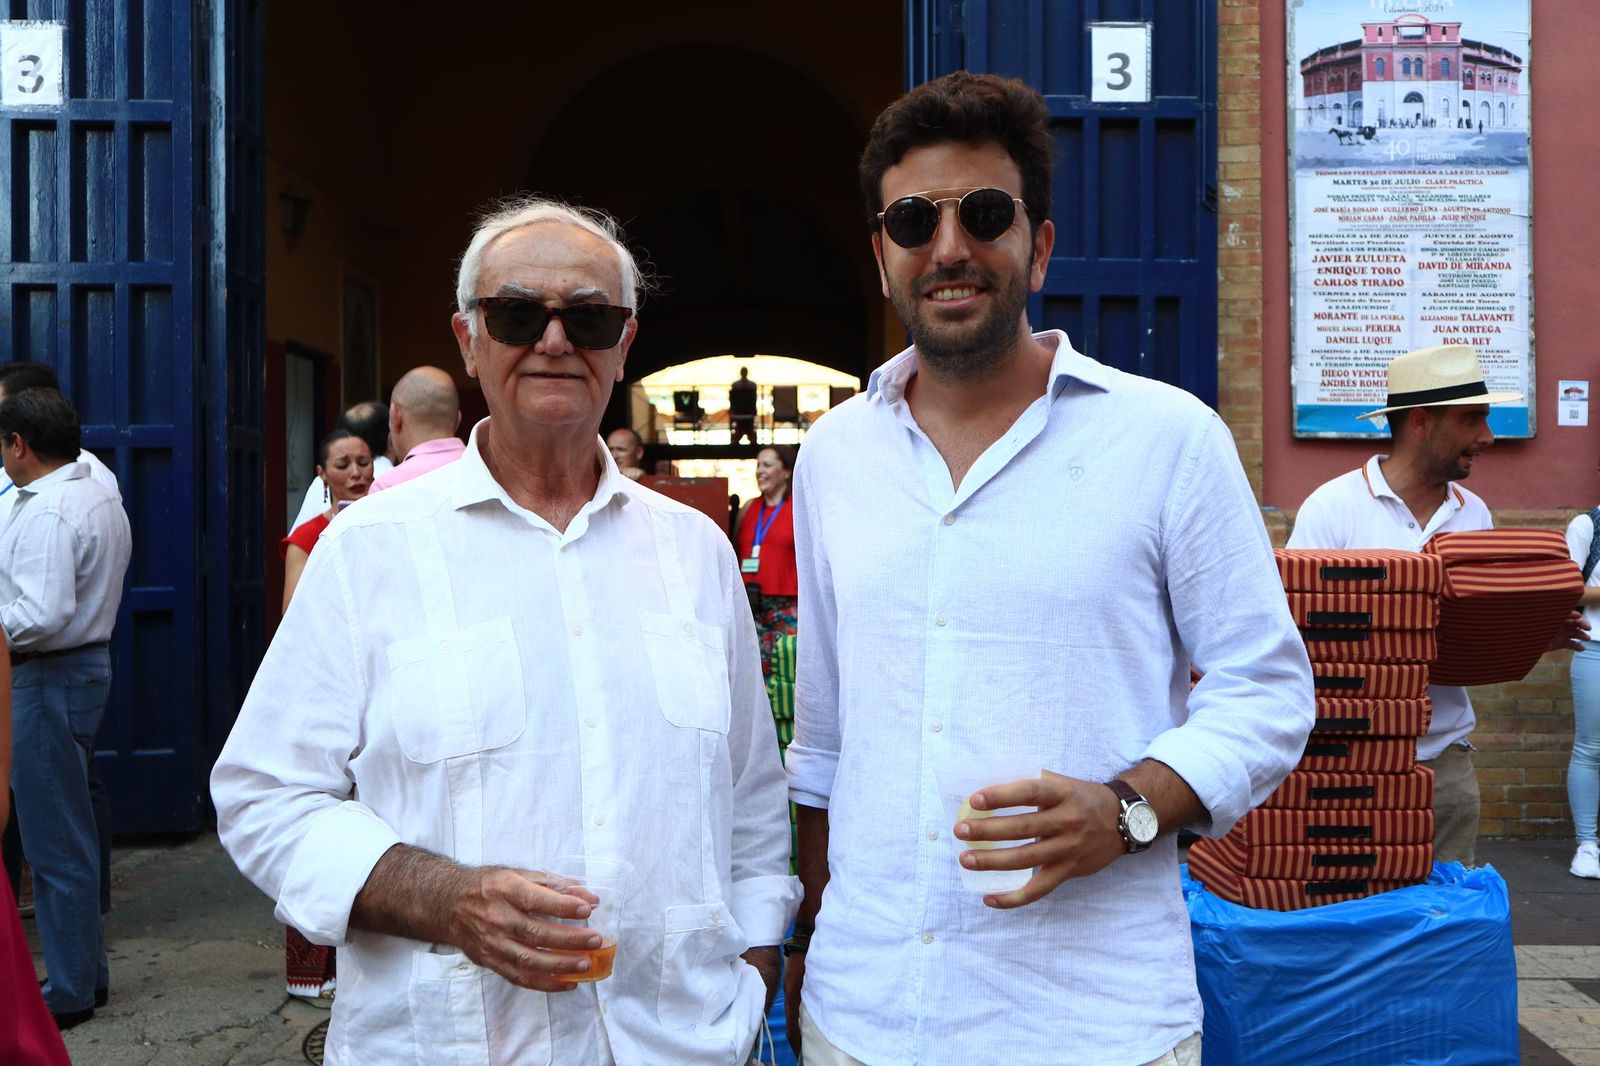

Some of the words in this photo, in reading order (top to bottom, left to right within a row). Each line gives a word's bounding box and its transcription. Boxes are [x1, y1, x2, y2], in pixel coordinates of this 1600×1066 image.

[18, 54, 44, 93] 3
[1107, 52, 1132, 90] 3
[1383, 139, 1411, 160] 40
[1312, 254, 1352, 262] JAVIER
[1356, 254, 1406, 262] ZULUETA
[1418, 262, 1448, 270] DAVID
[1451, 262, 1463, 270] DE
[1466, 262, 1512, 270] MIRANDA
[1317, 267, 1368, 276] ENRIQUE
[1314, 279, 1358, 287] CARLOS
[1361, 279, 1404, 287] TIRADO
[1314, 312, 1359, 320] MORANTE
[1460, 313, 1515, 321] TALAVANTE
[1365, 324, 1402, 333] PERERA
[1433, 325, 1460, 333] JUAN
[1462, 325, 1501, 333] ORTEGA
[1326, 336, 1360, 344] DANIEL
[1362, 336, 1393, 345] LUQUE
[1443, 337, 1469, 345] ROCA
[1472, 337, 1491, 345] REY
[1322, 369, 1350, 377] DIEGO
[1320, 378, 1357, 387] ANDRÉS
